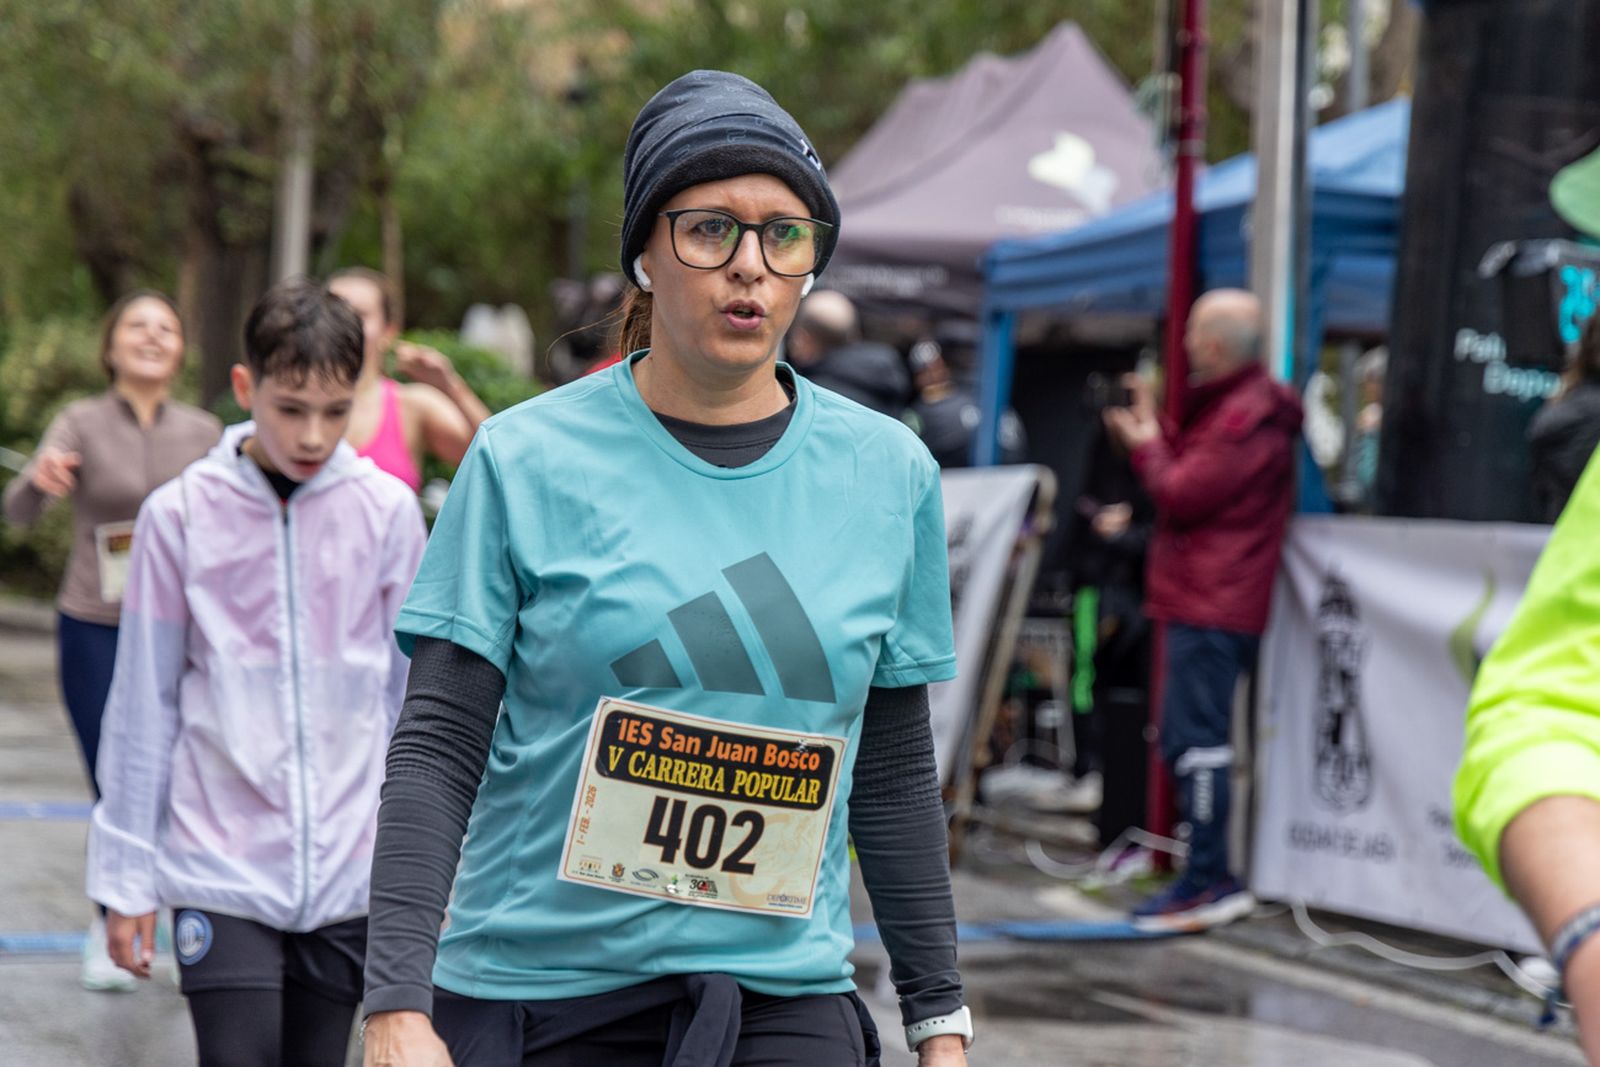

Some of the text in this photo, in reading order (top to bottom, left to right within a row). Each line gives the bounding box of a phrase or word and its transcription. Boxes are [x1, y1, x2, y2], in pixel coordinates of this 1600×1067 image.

[618, 718, 820, 771] IES San Juan Bosco
[585, 784, 597, 808] 2026
[608, 745, 821, 804] V CARRERA POPULAR
[643, 795, 765, 875] 402
